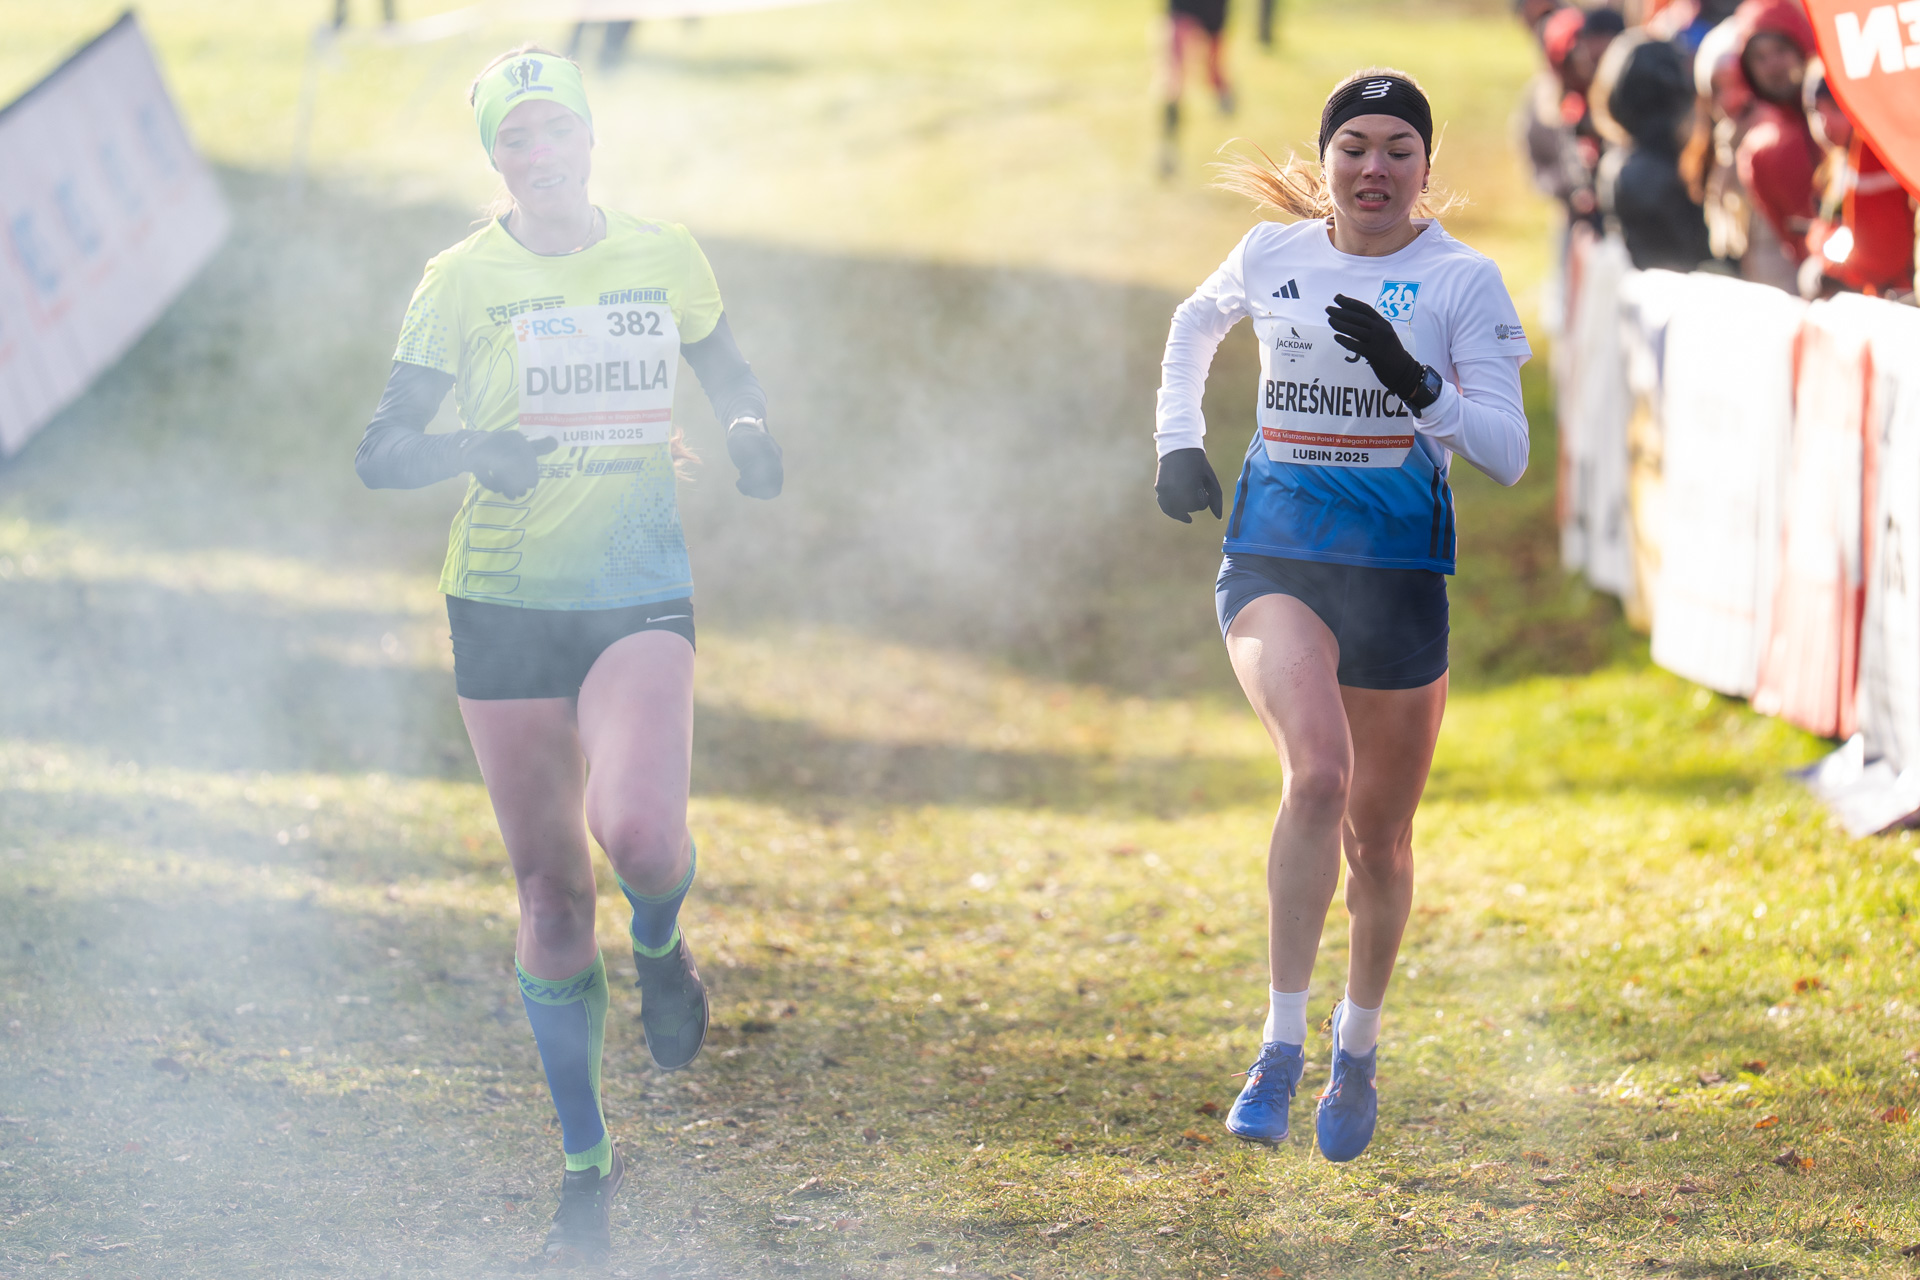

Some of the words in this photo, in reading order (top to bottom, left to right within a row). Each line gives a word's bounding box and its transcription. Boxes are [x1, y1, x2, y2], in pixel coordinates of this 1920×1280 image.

[598, 287, 669, 305] SONAROL
[606, 310, 664, 337] 382
[1275, 337, 1313, 350] JACKDAW
[526, 360, 668, 396] DUBIELLA
[1266, 378, 1409, 418] BEREŚNIEWICZ
[563, 430, 605, 442] LUBIN
[608, 428, 643, 440] 2025
[1317, 435, 1335, 443] Polski
[1293, 449, 1332, 462] LUBIN
[1335, 451, 1370, 463] 2025
